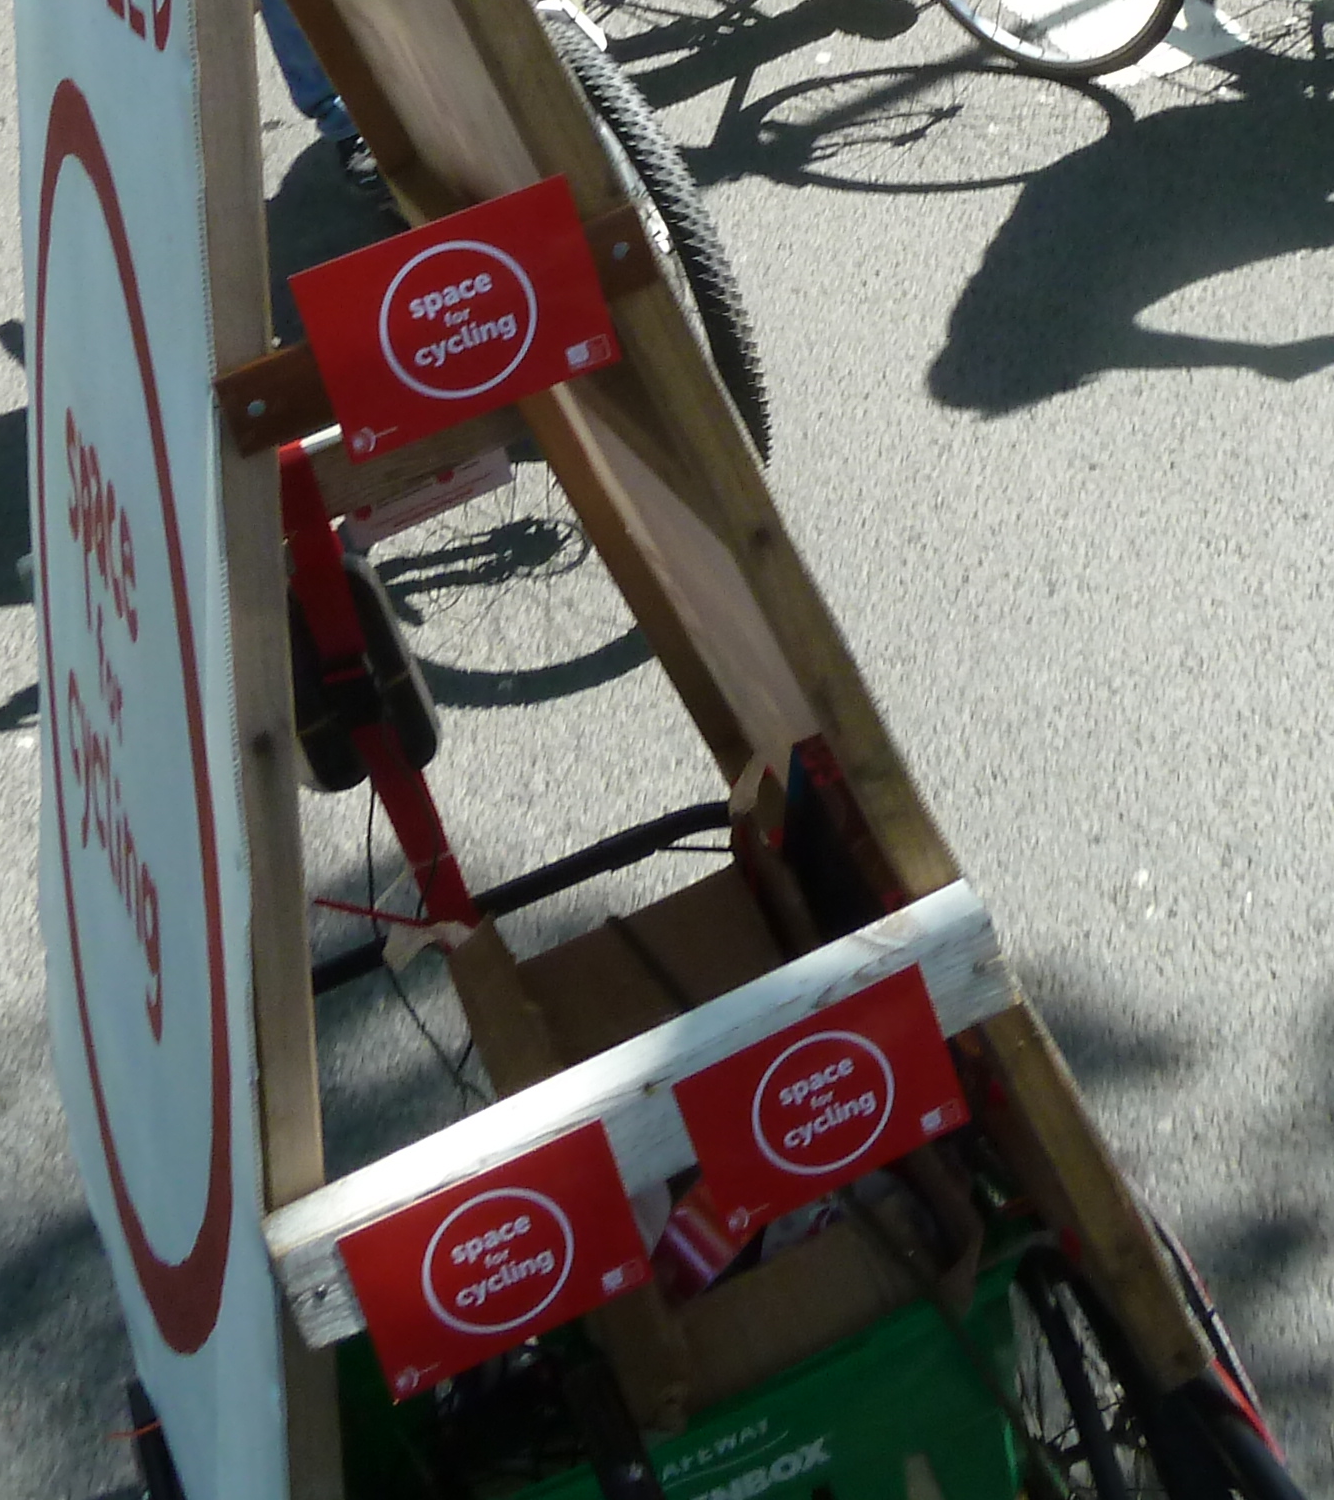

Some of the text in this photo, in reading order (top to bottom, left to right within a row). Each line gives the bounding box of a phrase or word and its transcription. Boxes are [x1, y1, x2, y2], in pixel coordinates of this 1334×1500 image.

[408, 272, 493, 320] space
[443, 307, 471, 328] for
[414, 312, 518, 368] cycling
[66, 406, 139, 643] space
[69, 667, 164, 1045] cycling
[779, 1056, 855, 1107] space
[809, 1089, 835, 1111] for
[783, 1089, 877, 1149] cycling
[450, 1214, 532, 1266] space
[483, 1247, 510, 1270] for
[455, 1248, 555, 1308] cycling
[661, 1415, 768, 1483] AFEWAY
